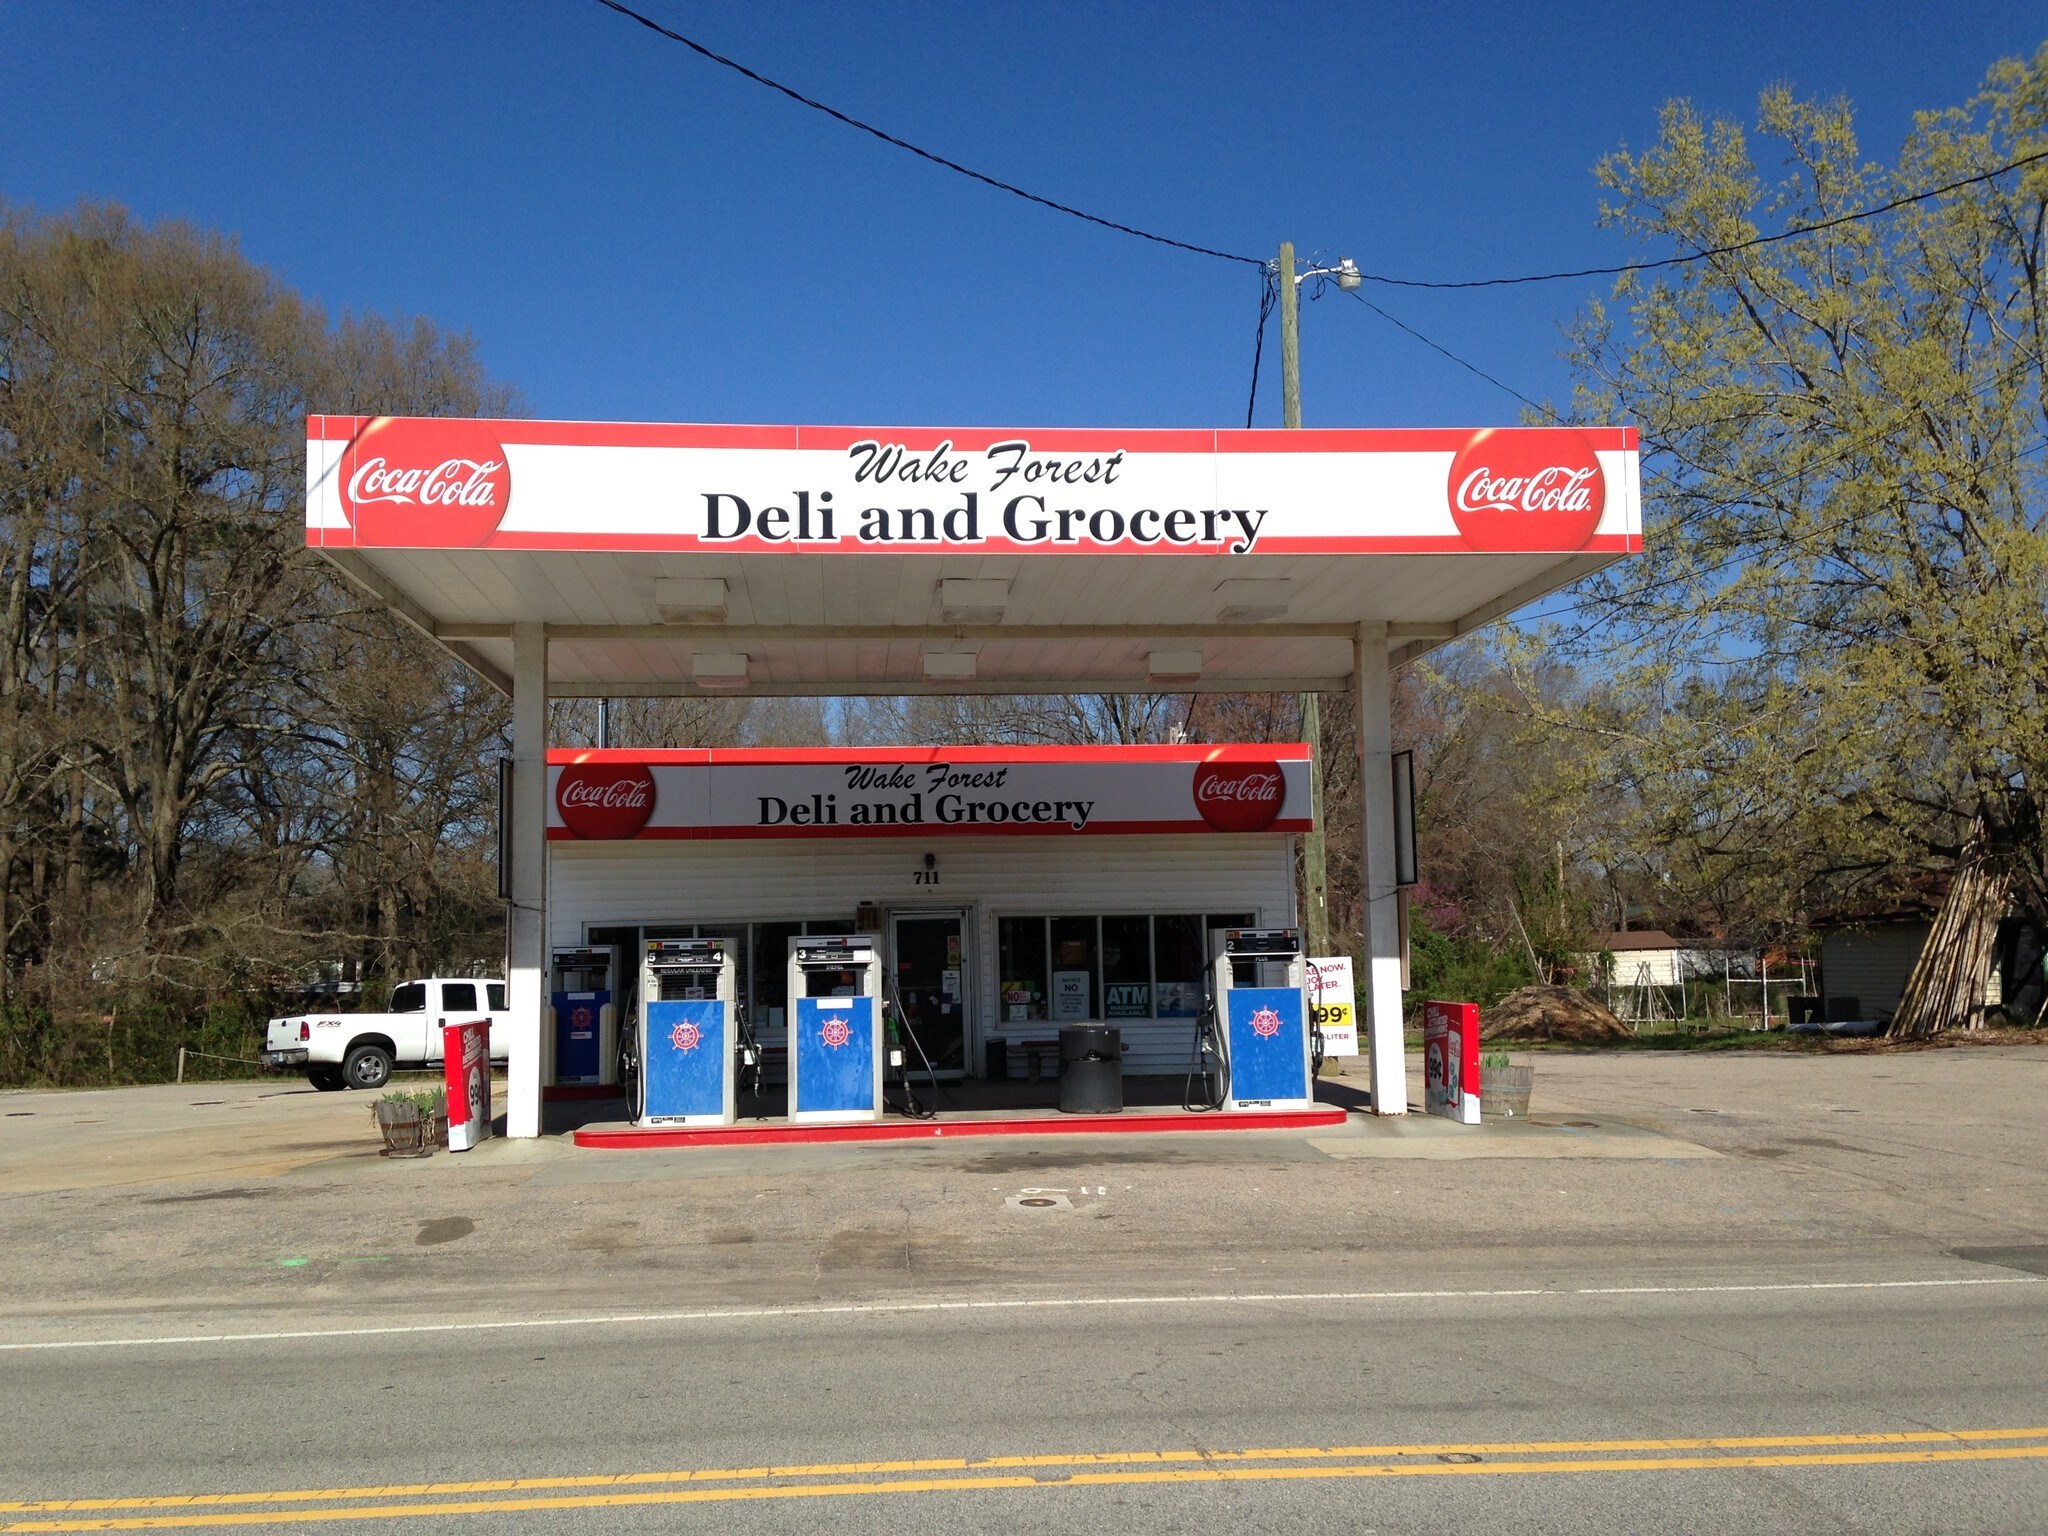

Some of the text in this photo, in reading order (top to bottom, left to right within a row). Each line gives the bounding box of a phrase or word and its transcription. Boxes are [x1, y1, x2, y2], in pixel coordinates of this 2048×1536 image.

[850, 443, 1123, 492] Wake Forest
[347, 457, 504, 506] Coca-Cola
[1456, 466, 1598, 512] Coca-Cola
[701, 491, 1269, 554] Deli and Grocery
[844, 763, 1008, 794] Wake Forest
[561, 779, 651, 808] Coca-Cola
[1198, 773, 1281, 802] Coca-Cola
[757, 793, 1095, 829] Deli and Grocery
[913, 871, 940, 885] 711
[1227, 940, 1235, 950] 2
[1291, 940, 1297, 949] 1
[553, 955, 560, 963] 6
[648, 952, 656, 962] 5
[712, 951, 722, 962] 4
[798, 949, 807, 959] 3
[1320, 962, 1346, 974] NOW.
[1064, 983, 1079, 992] NO
[1007, 991, 1020, 1001] NO
[1106, 986, 1149, 1005] ATM
